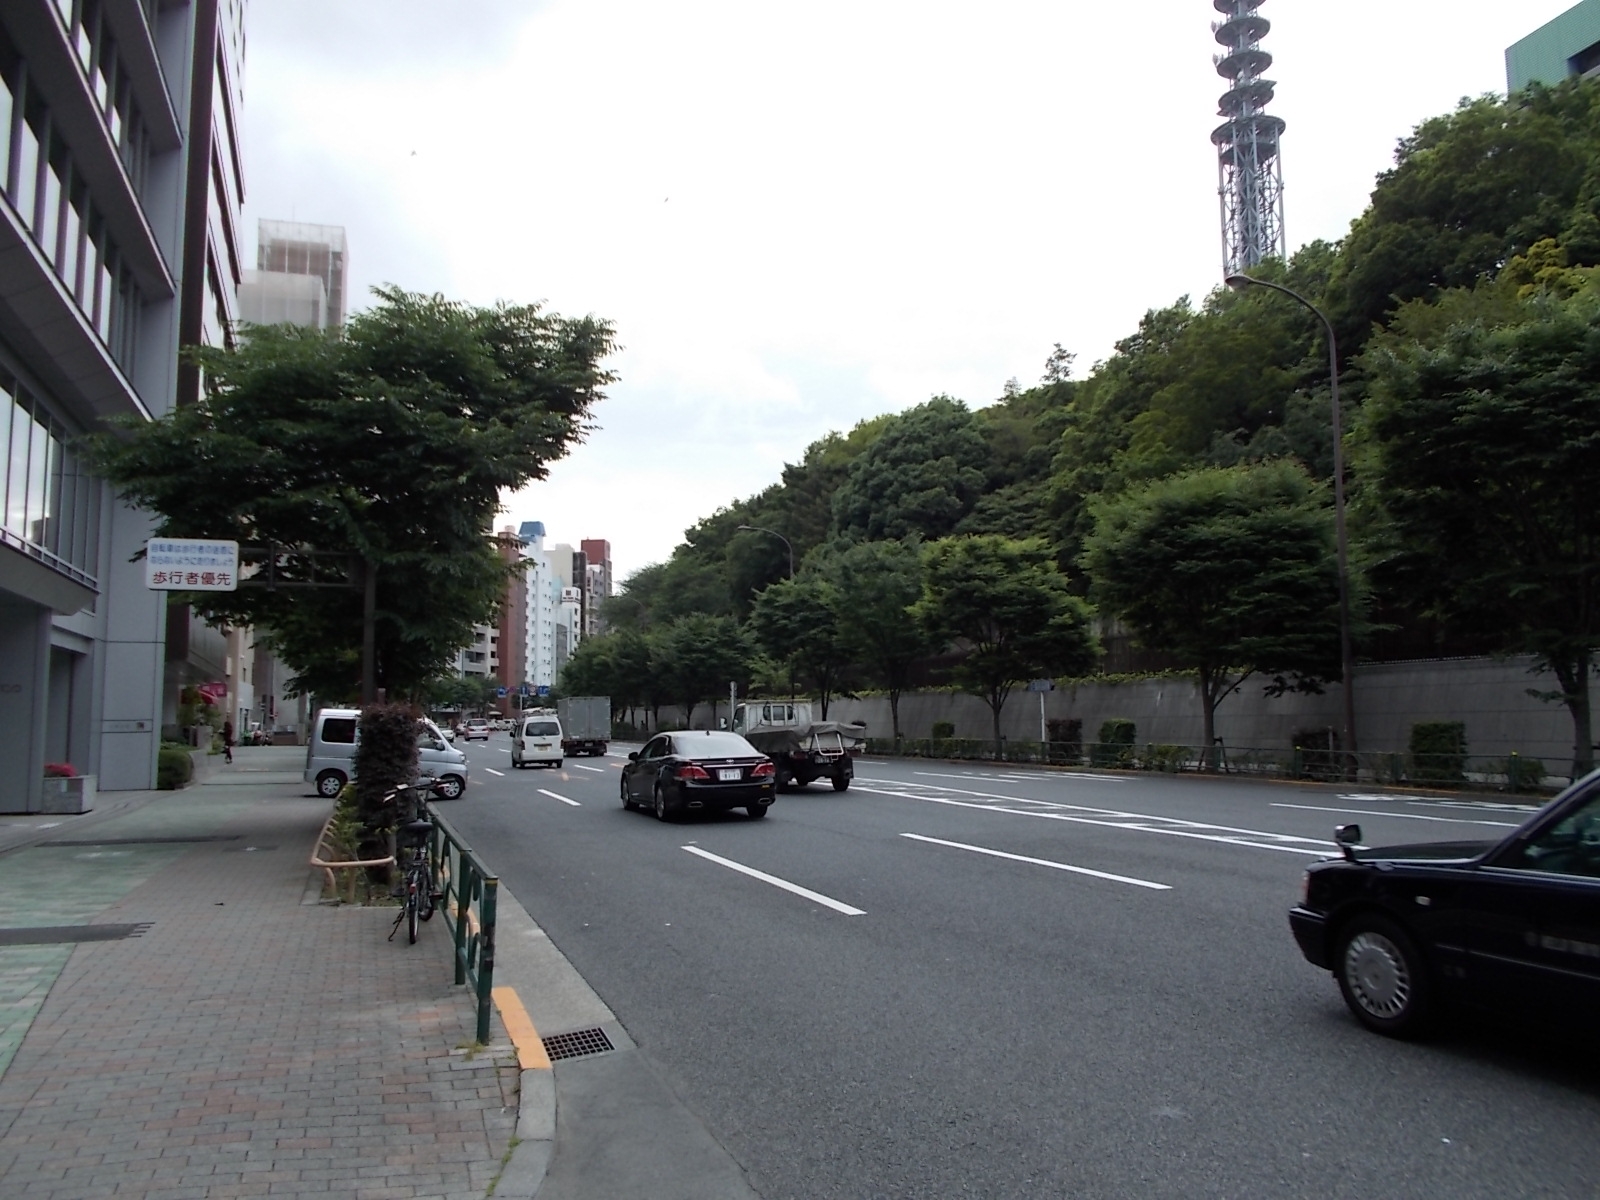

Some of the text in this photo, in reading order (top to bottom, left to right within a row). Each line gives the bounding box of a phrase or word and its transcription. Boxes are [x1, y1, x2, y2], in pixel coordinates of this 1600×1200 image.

[153, 571, 231, 585] 歩行者優先
